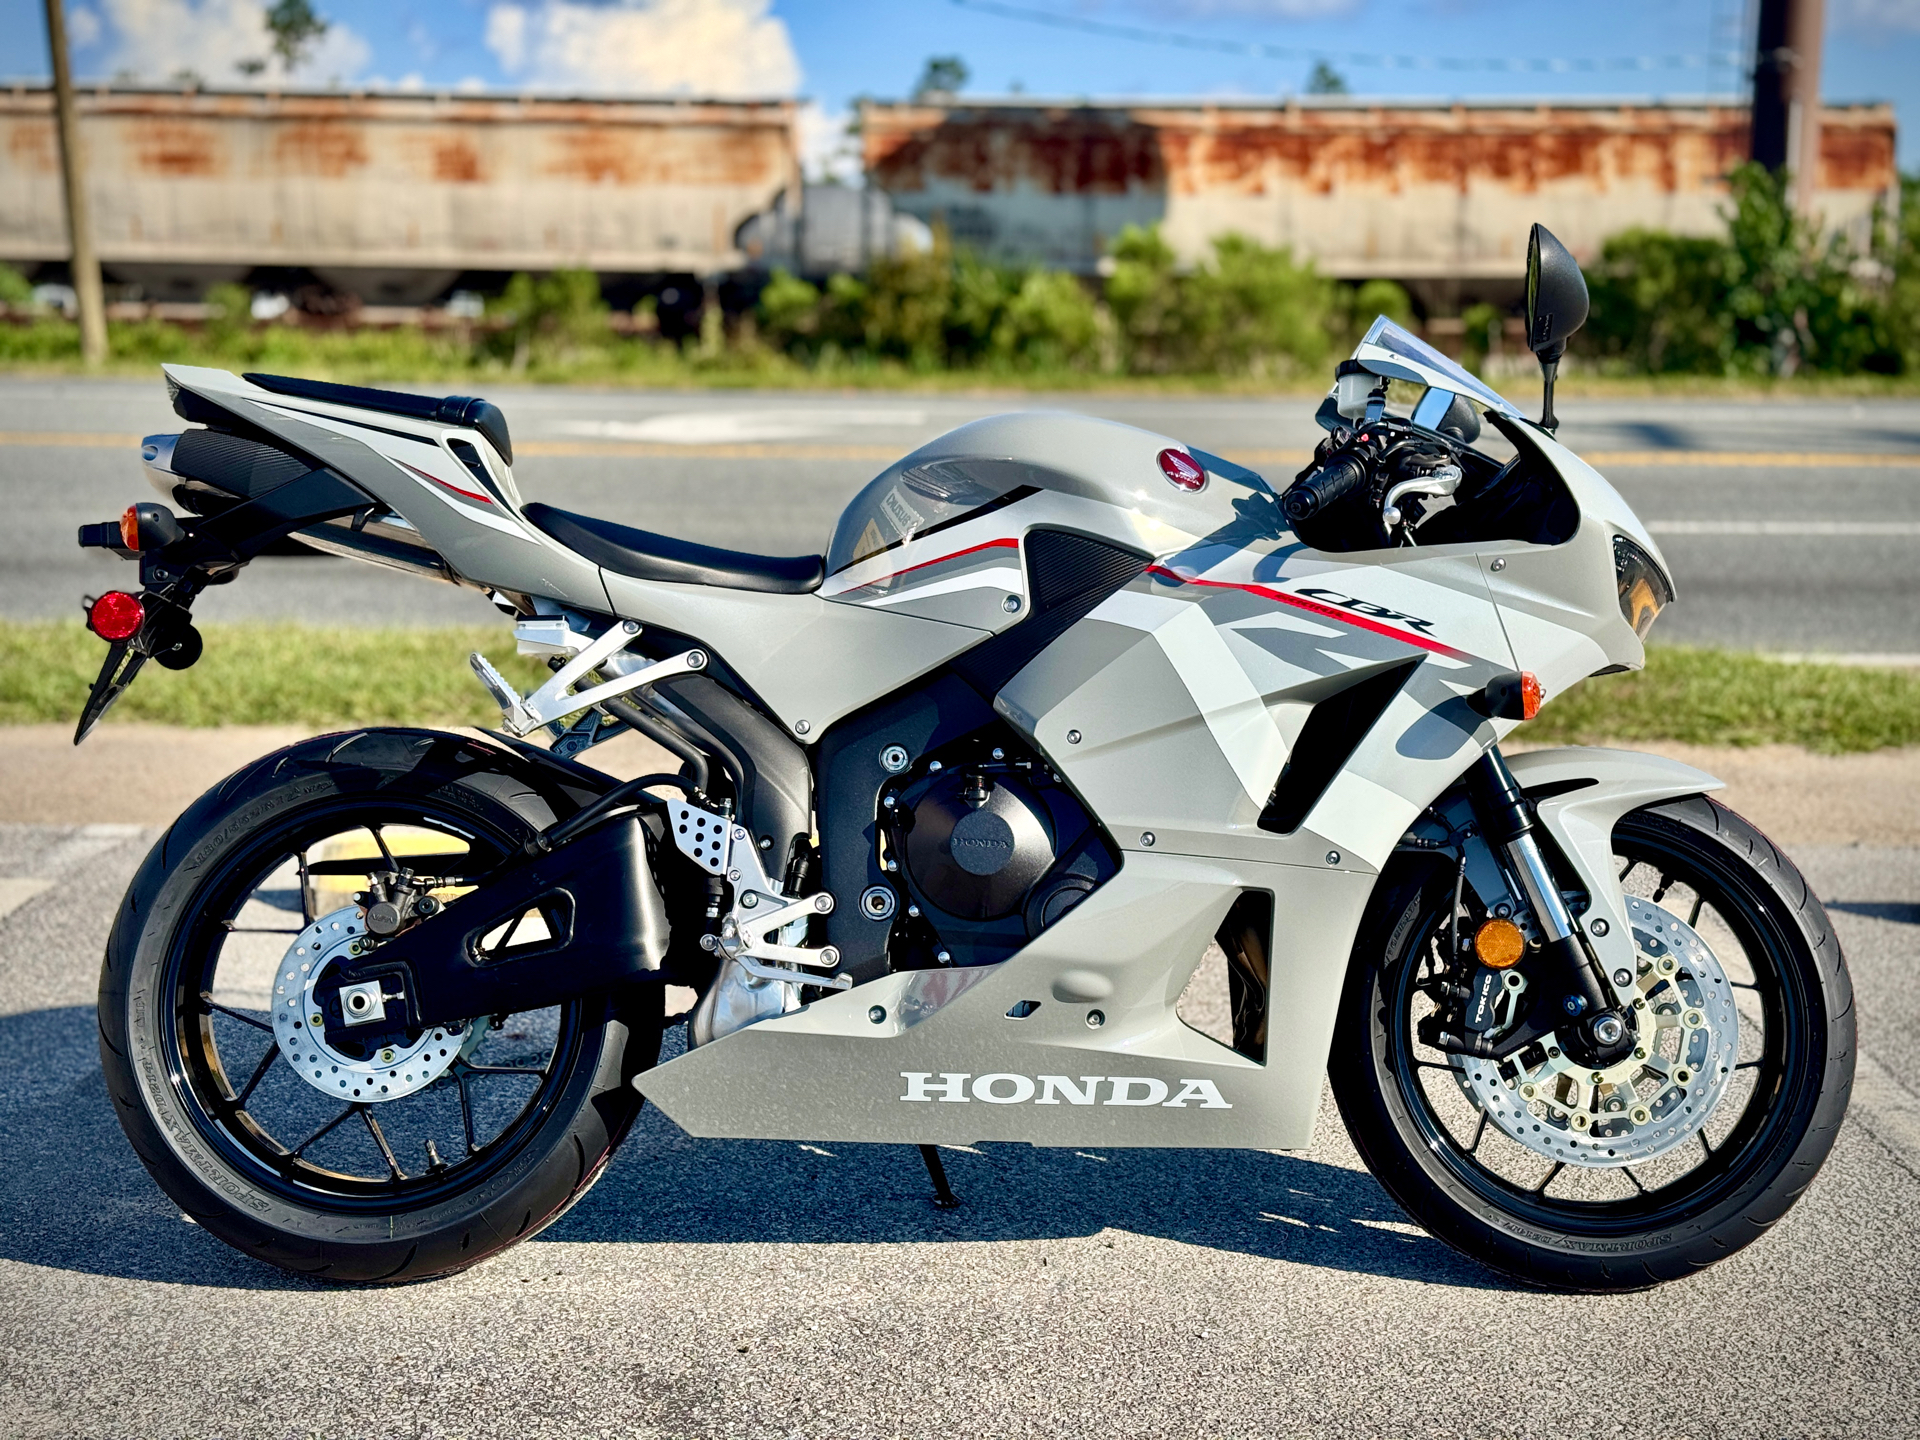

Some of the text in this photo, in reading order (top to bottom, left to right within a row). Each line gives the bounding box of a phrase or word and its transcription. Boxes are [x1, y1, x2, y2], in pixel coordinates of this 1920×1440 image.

[1294, 588, 1438, 638] CBR
[953, 838, 1010, 849] HONDA
[1475, 974, 1492, 1023] TOKICO
[900, 1071, 1233, 1109] HONDA
[142, 1060, 270, 1213] SPORTMAX D214
[1562, 1233, 1672, 1251] SPORTMAX
